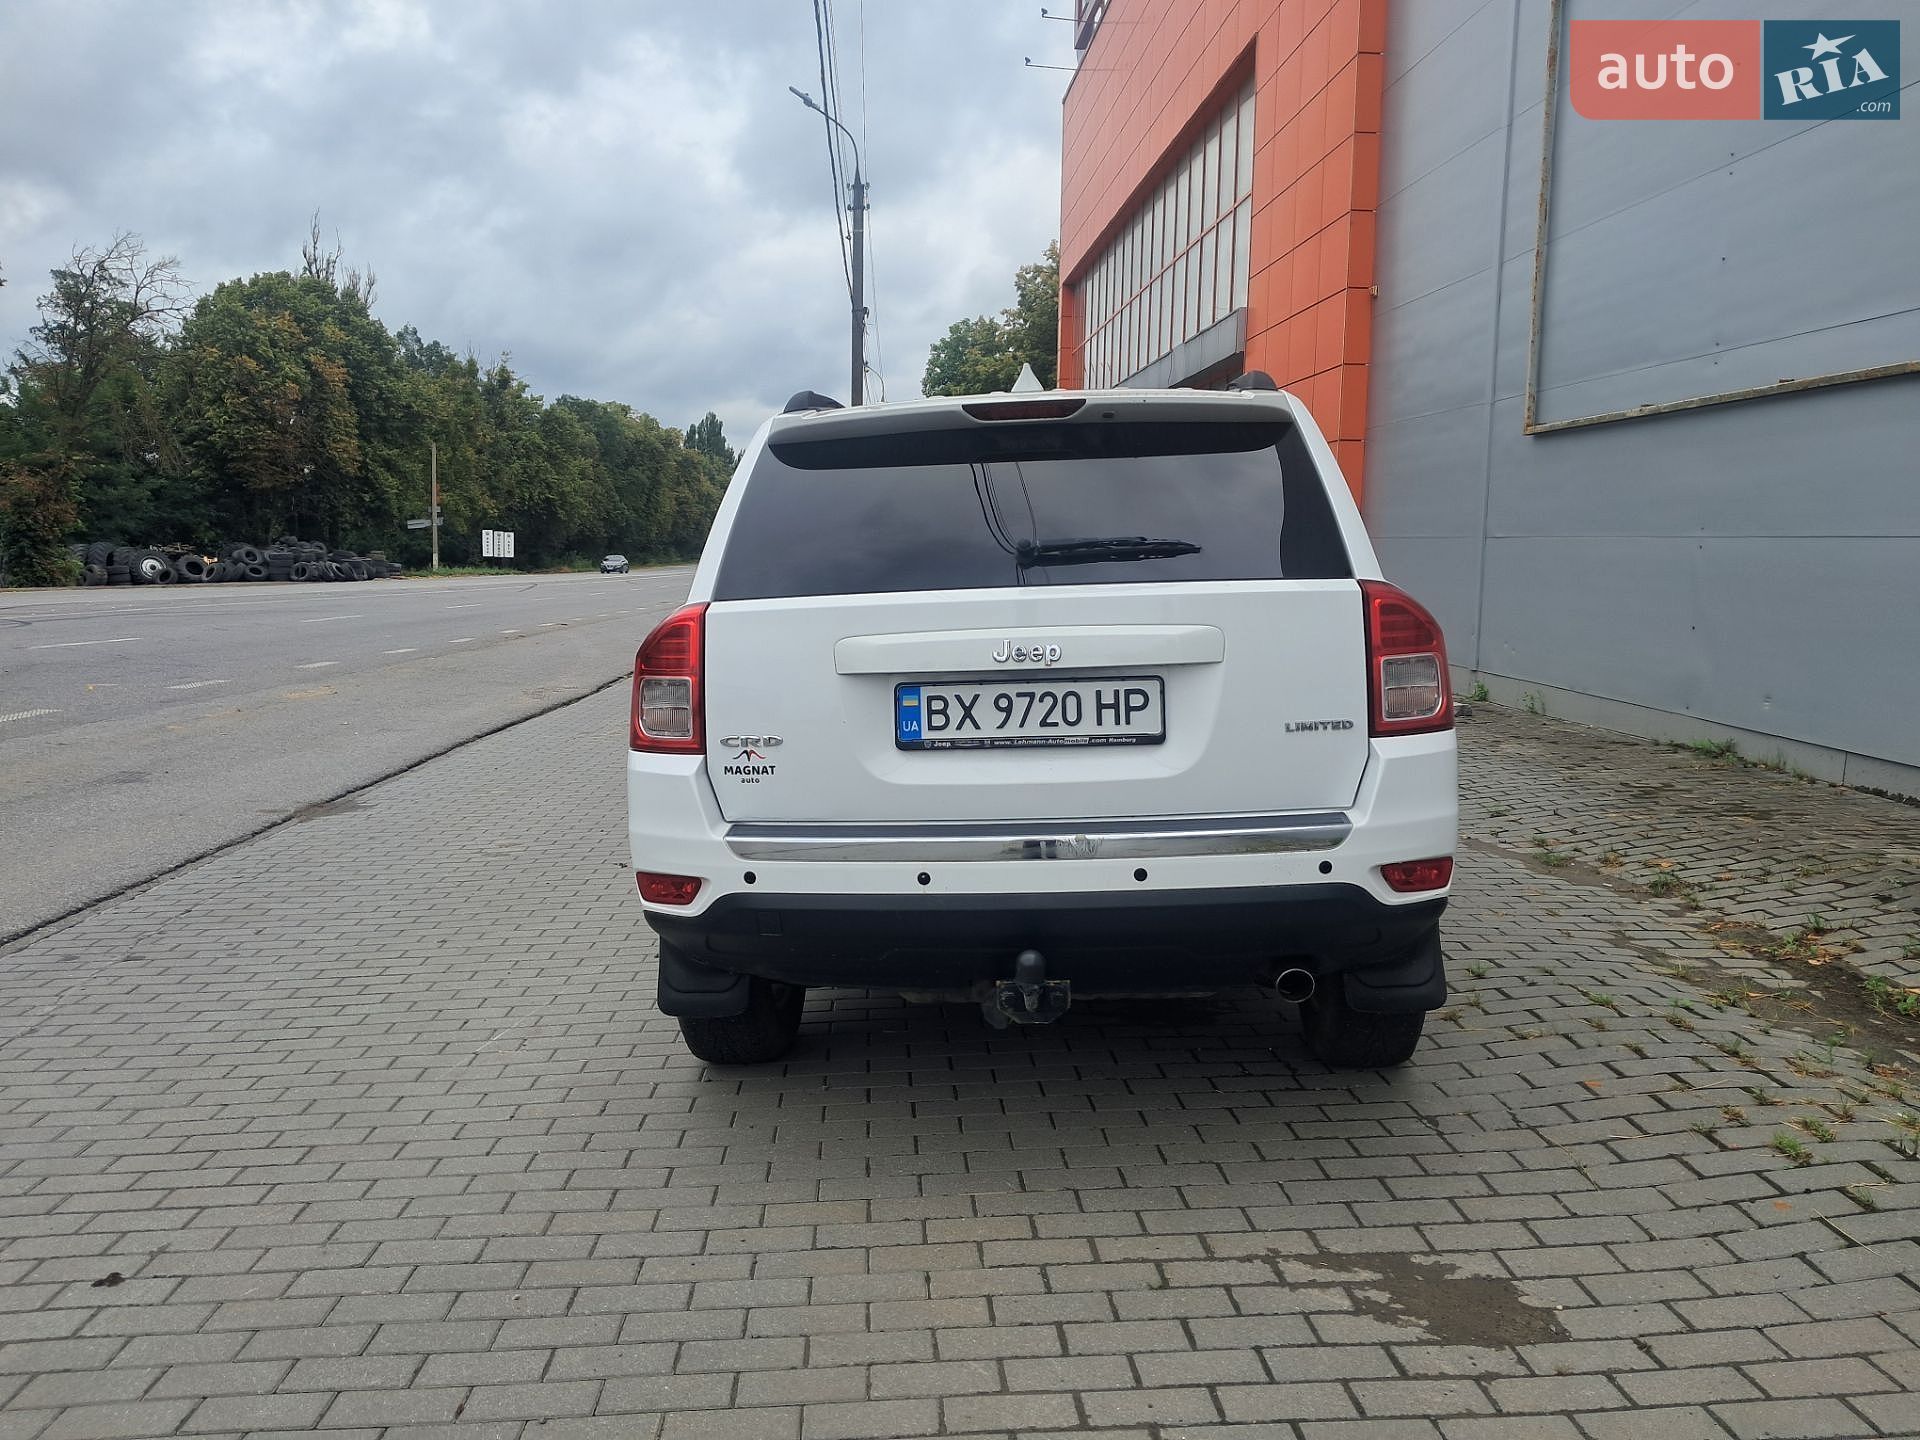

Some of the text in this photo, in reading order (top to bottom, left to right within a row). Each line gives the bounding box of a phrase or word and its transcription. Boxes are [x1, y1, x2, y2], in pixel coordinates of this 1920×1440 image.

[992, 639, 1062, 666] Jeep
[926, 688, 1150, 731] BX 9720 HP
[902, 720, 919, 732] UA
[1284, 720, 1354, 732] LIMITED
[720, 735, 783, 747] CRD
[724, 765, 776, 776] MAGNAT
